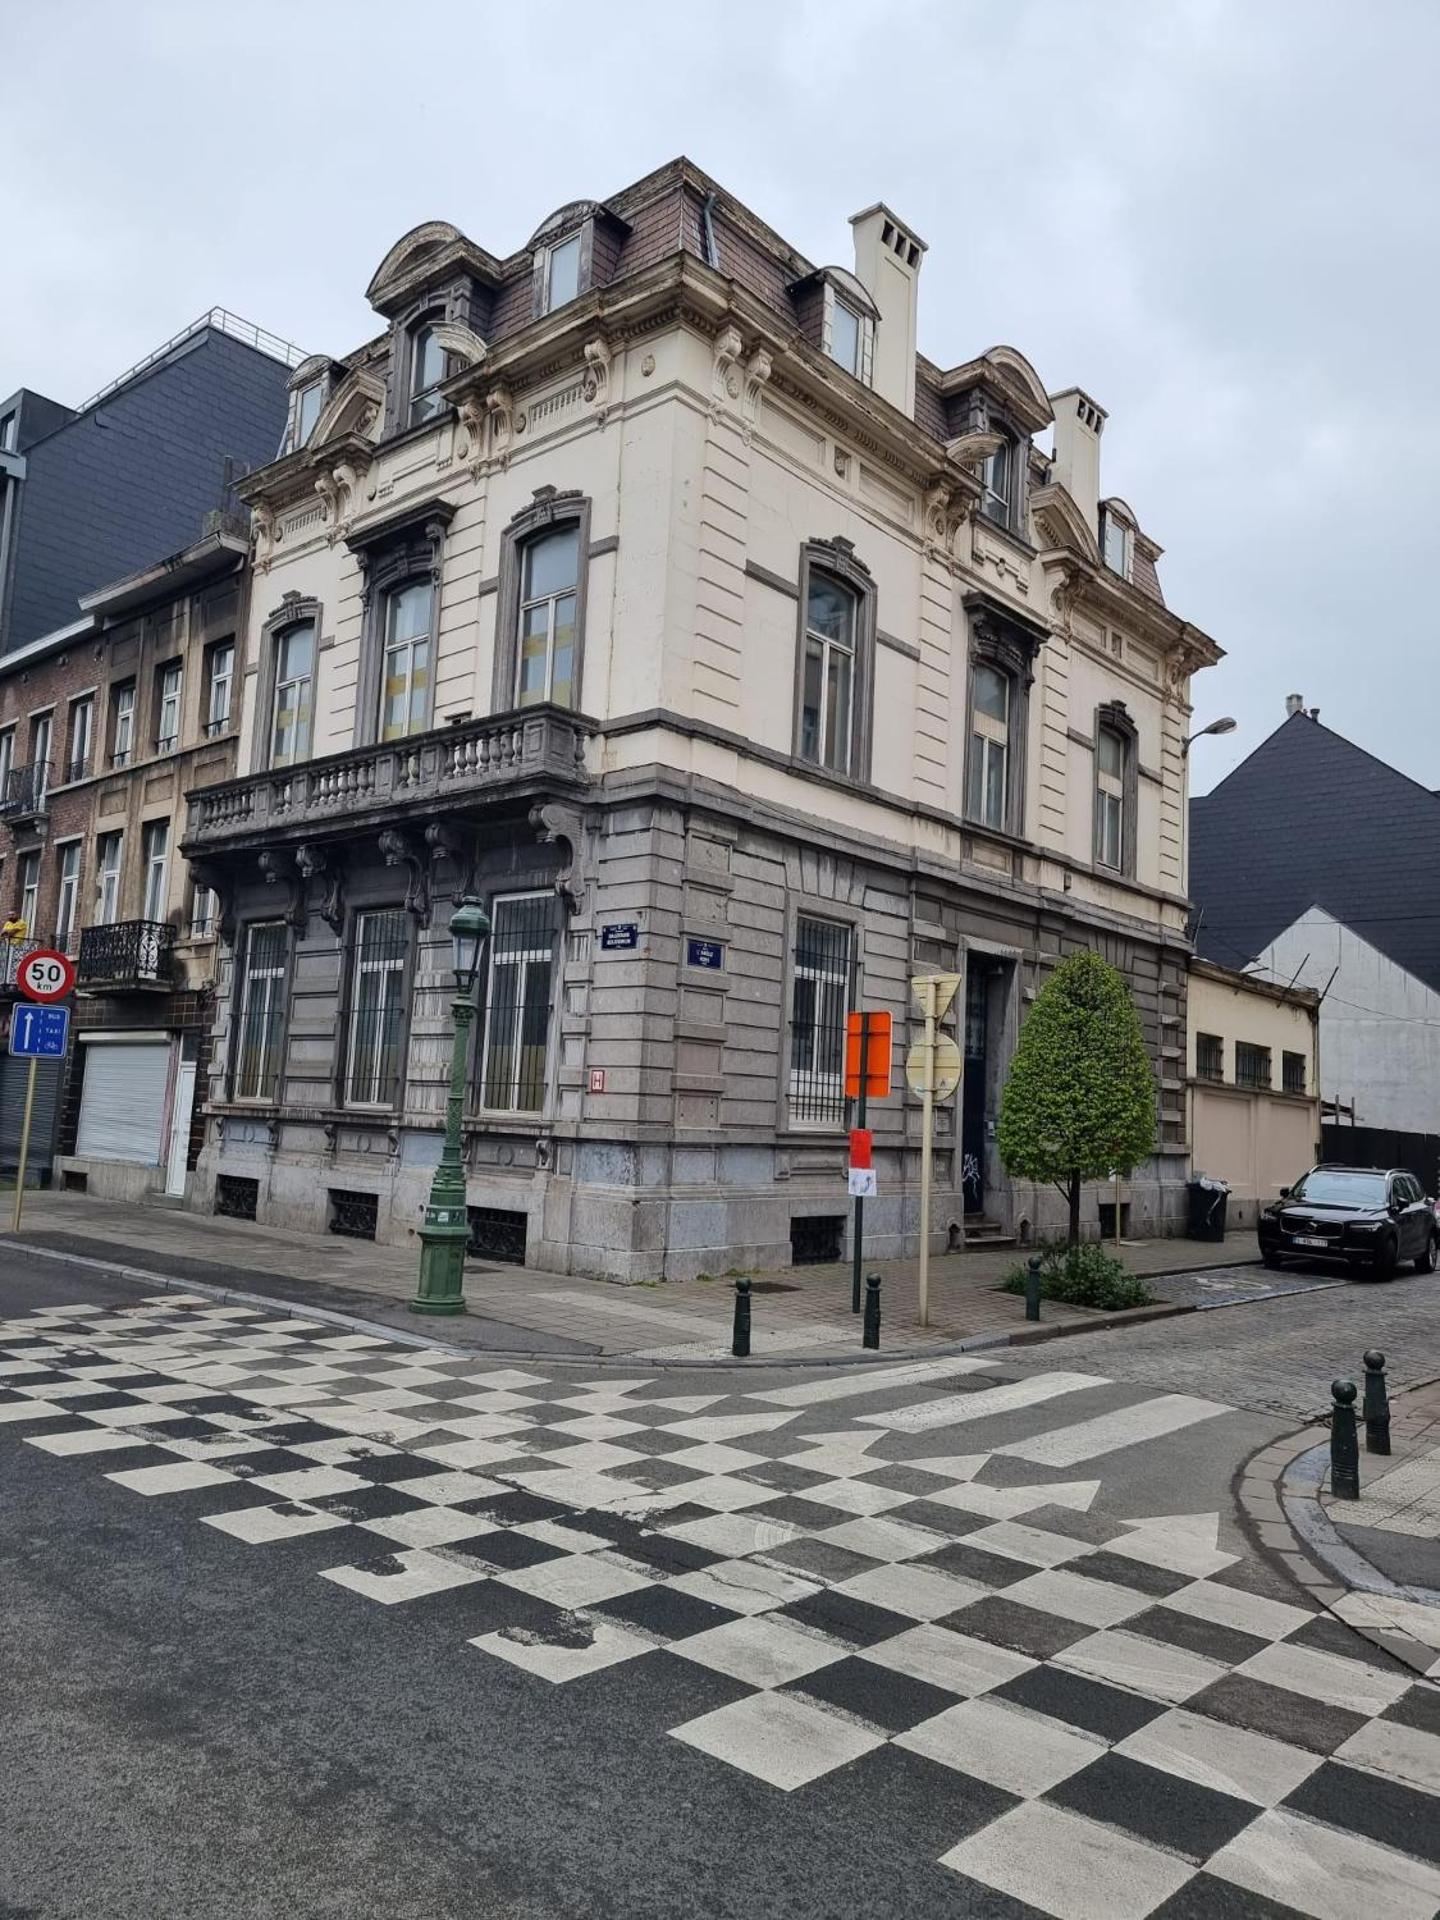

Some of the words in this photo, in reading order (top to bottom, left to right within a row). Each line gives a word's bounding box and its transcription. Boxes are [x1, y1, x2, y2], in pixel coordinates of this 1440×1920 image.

[32, 963, 61, 982] 50
[37, 982, 52, 991] km
[594, 1073, 601, 1088] H
